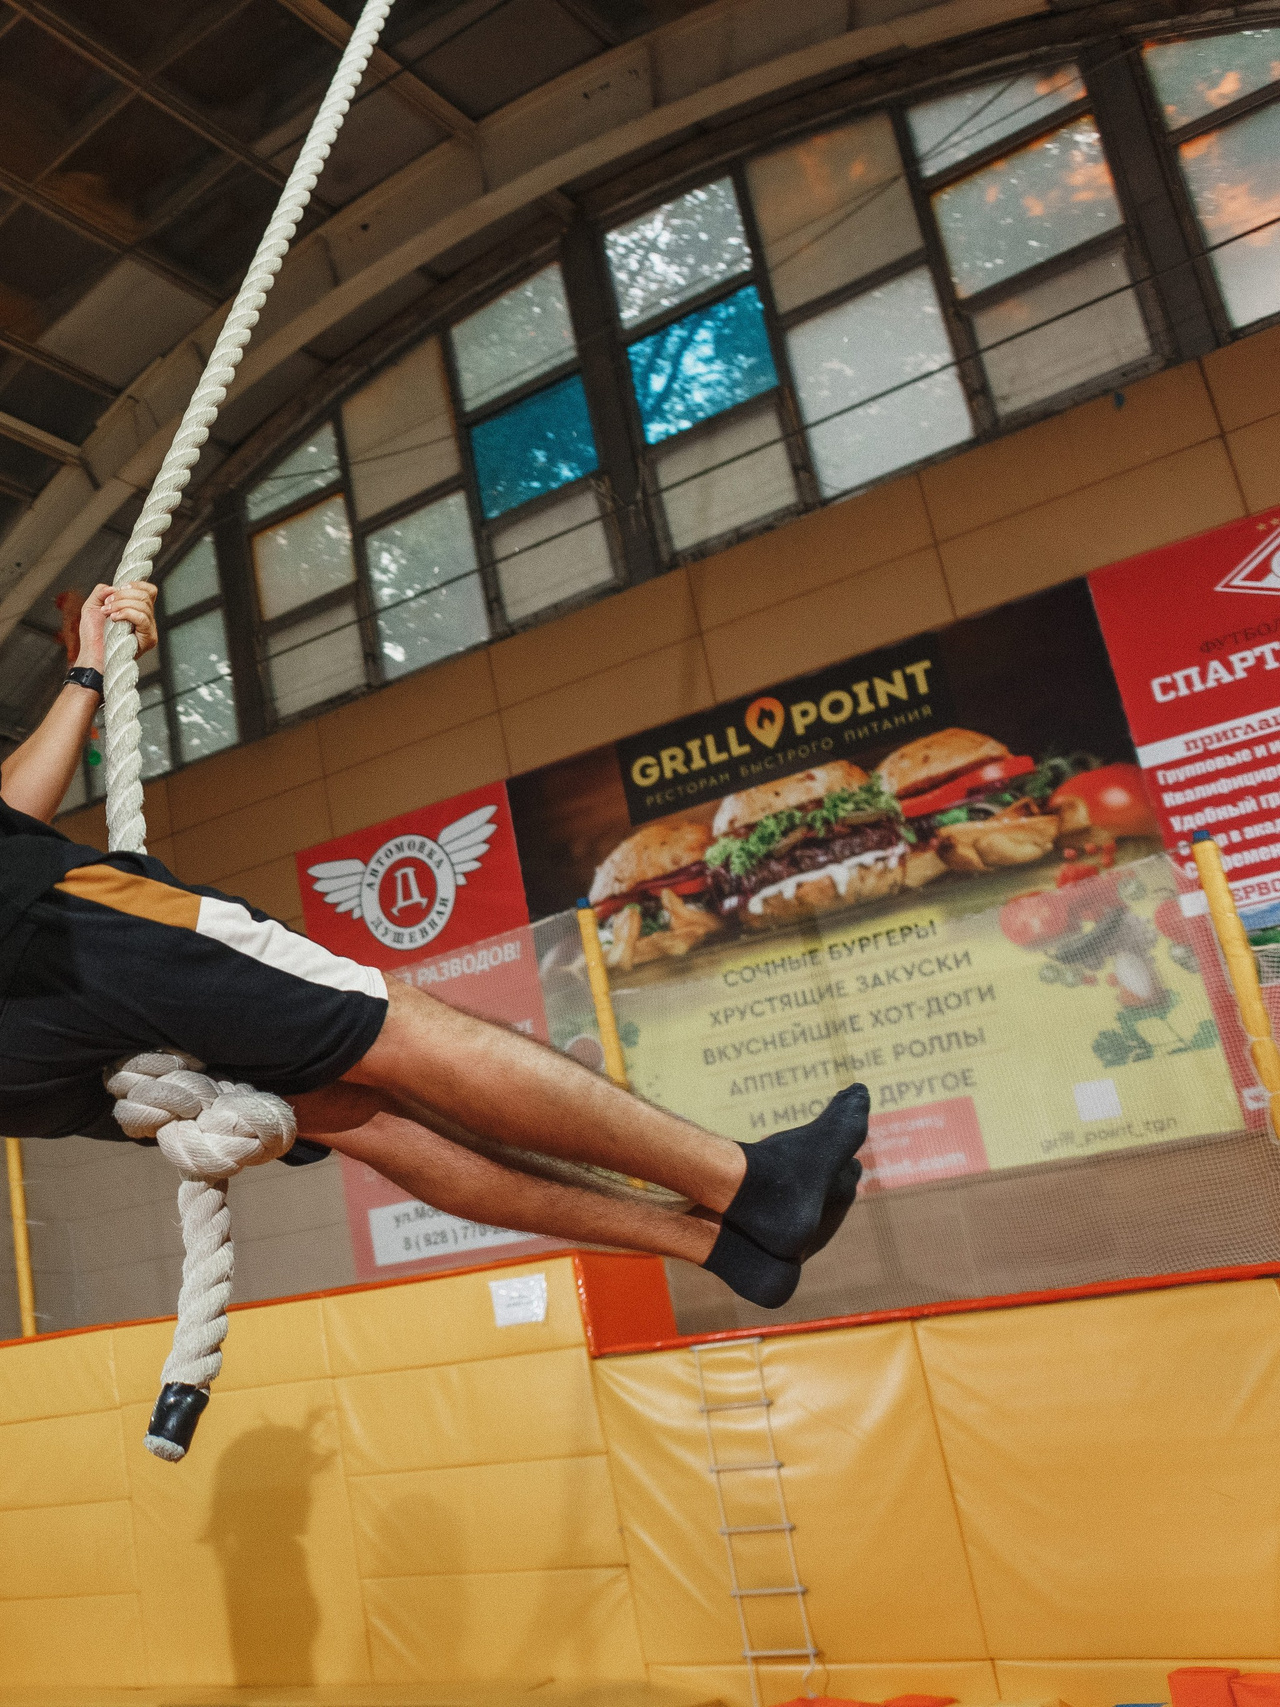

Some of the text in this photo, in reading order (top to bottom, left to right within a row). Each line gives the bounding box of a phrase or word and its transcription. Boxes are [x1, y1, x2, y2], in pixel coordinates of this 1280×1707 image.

[631, 660, 931, 787] GRILL POINT
[645, 704, 933, 806] РЕСТОРАН БЫСТРОГО ПИТАНИЯ
[1156, 748, 1253, 786] Групповые
[1253, 744, 1268, 758] и
[1169, 795, 1259, 833] Удобный
[366, 839, 444, 891] АВТОМОЙКА
[391, 866, 428, 917] Д
[371, 897, 449, 944] ДУШЕВНАЯ
[417, 941, 521, 988] РАЗВОДОВ!
[722, 919, 938, 988] СОЧНЫЕ БУРГЕРЫ
[709, 950, 973, 1027] ХРУСТЯЩИЕ ЗАКУСКИ
[703, 984, 998, 1066] ВКУСНЕЙШИЕ ХОТ-ДОГИ
[730, 1027, 986, 1097] АППЕТИТНЫЕ РОЛЛЫ
[748, 1068, 978, 1129] И МНО ДРУГОЕ
